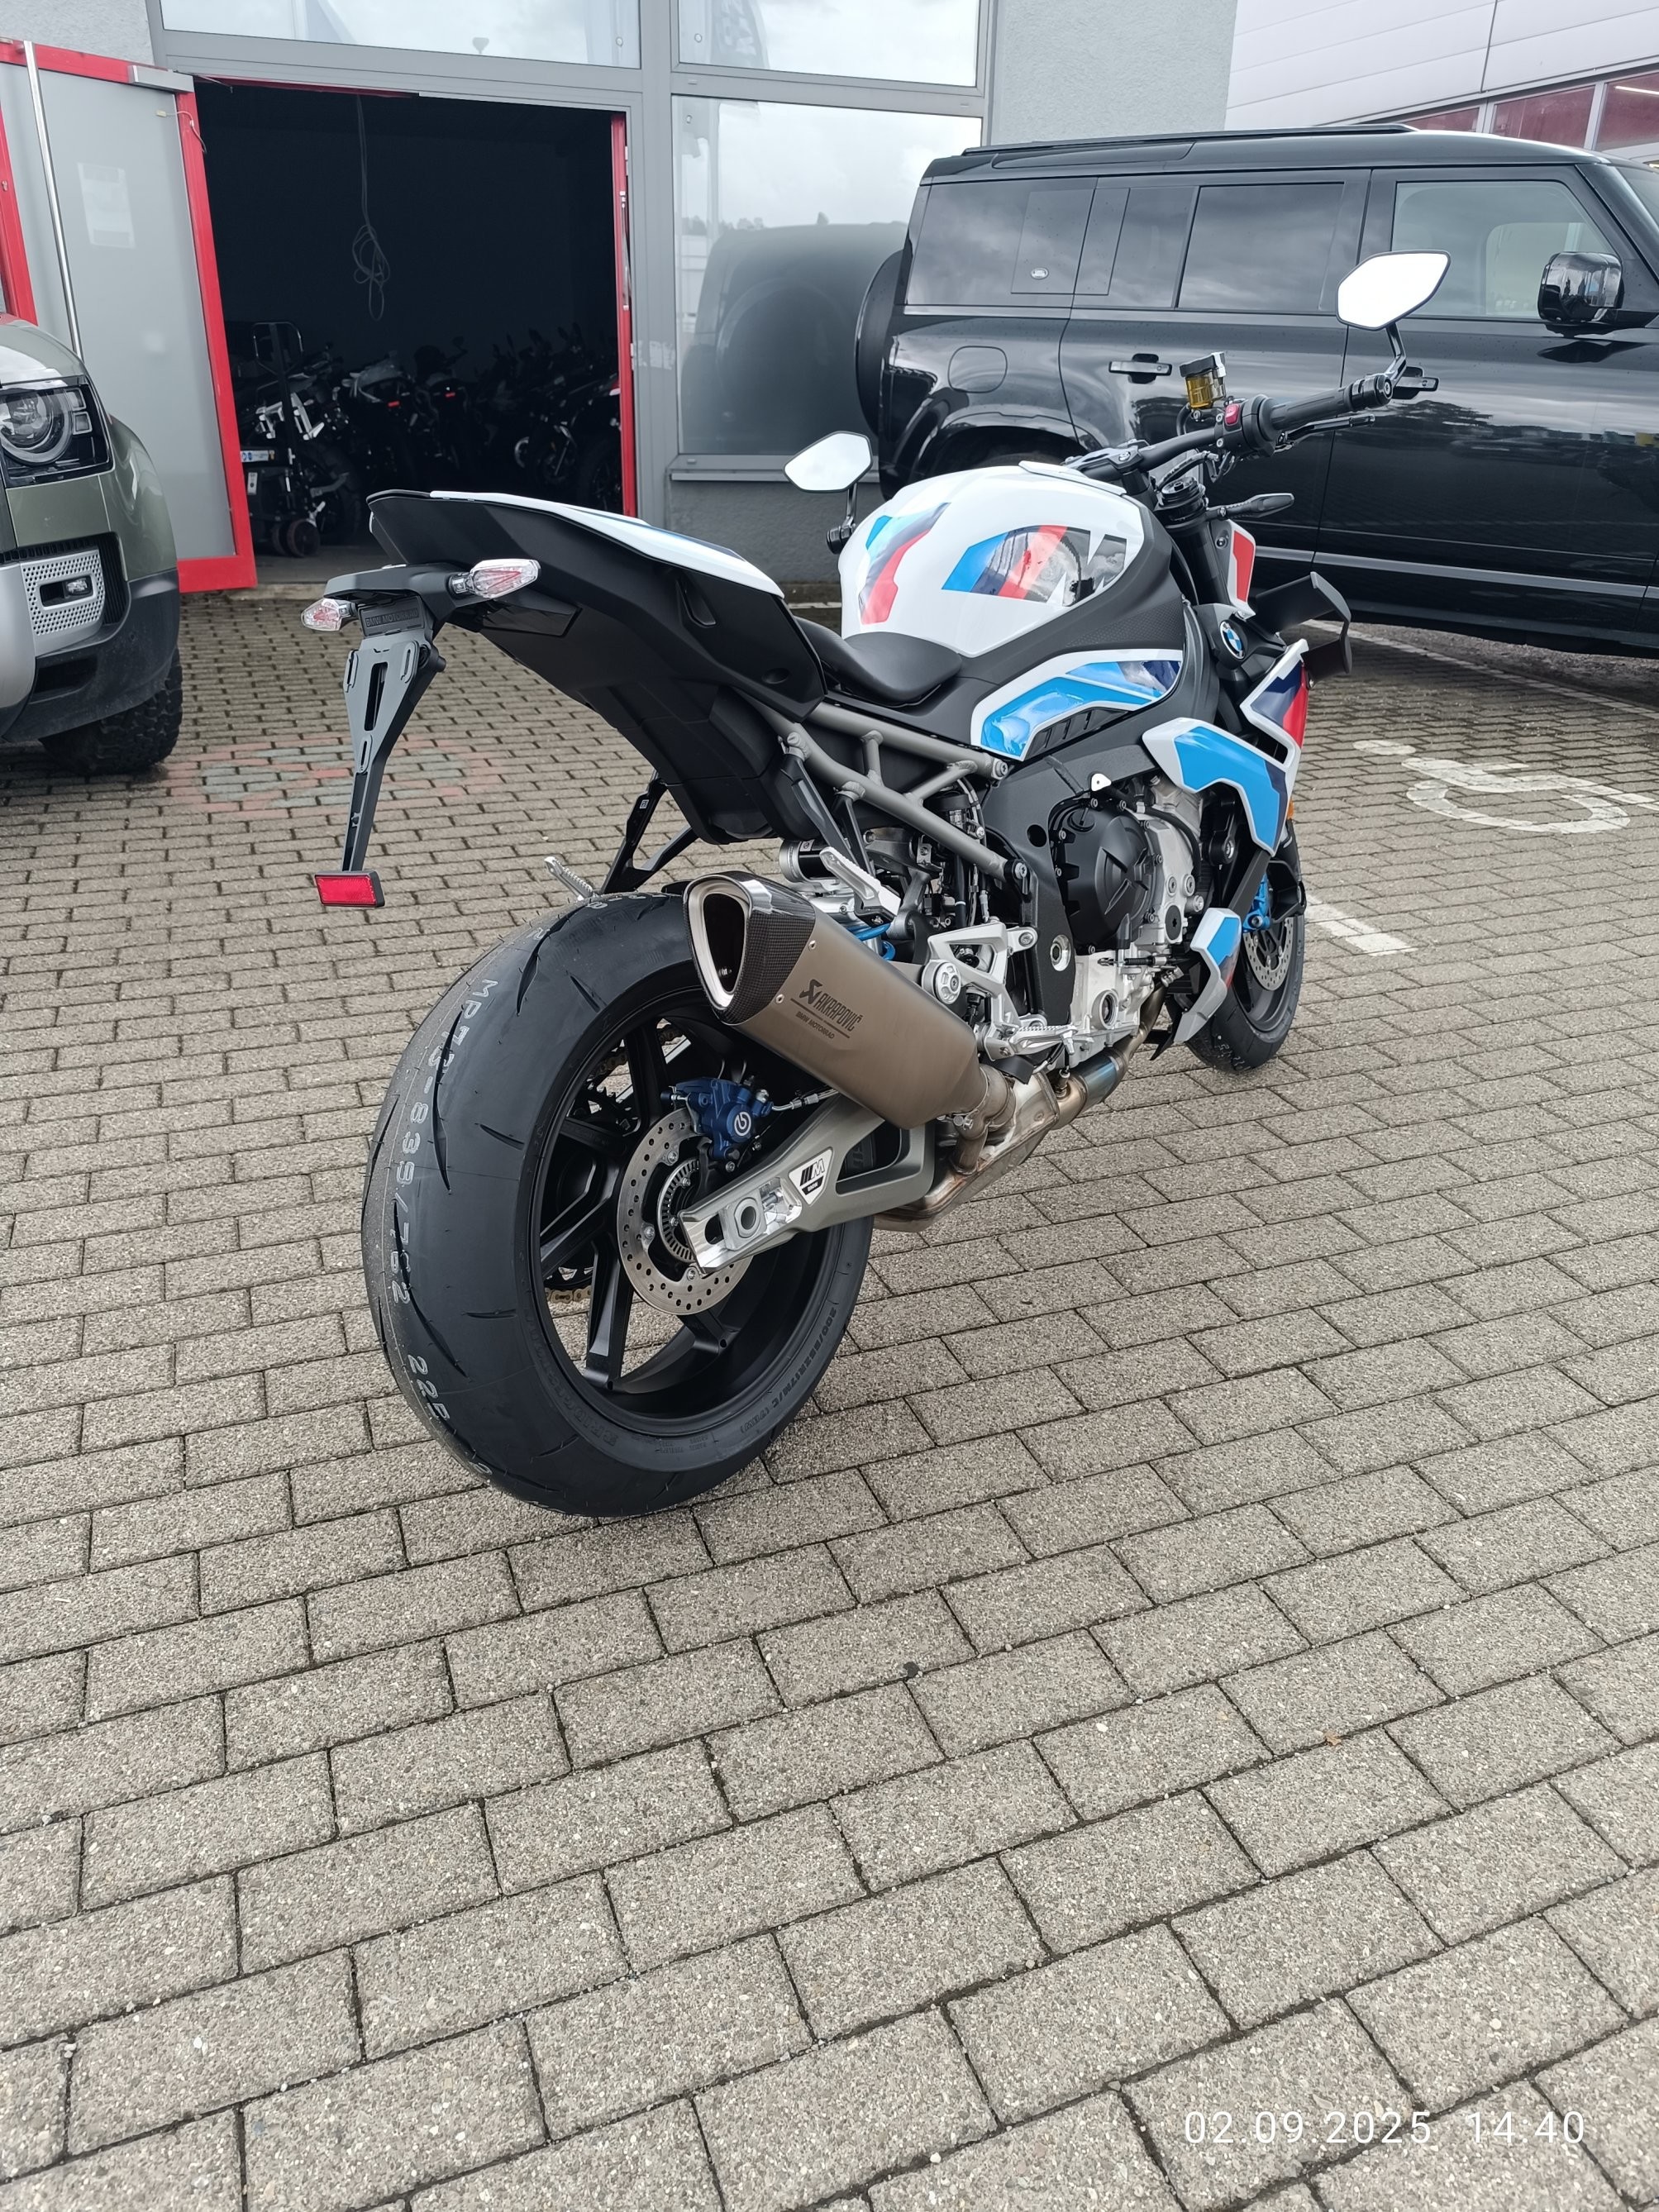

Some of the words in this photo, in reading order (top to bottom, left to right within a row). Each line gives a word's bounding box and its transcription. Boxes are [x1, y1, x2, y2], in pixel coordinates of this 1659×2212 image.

[365, 617, 381, 627] BMW
[382, 608, 418, 623] MOTORRAD
[795, 1011, 810, 1023] BMW
[808, 1021, 835, 1039] MOTORRAD
